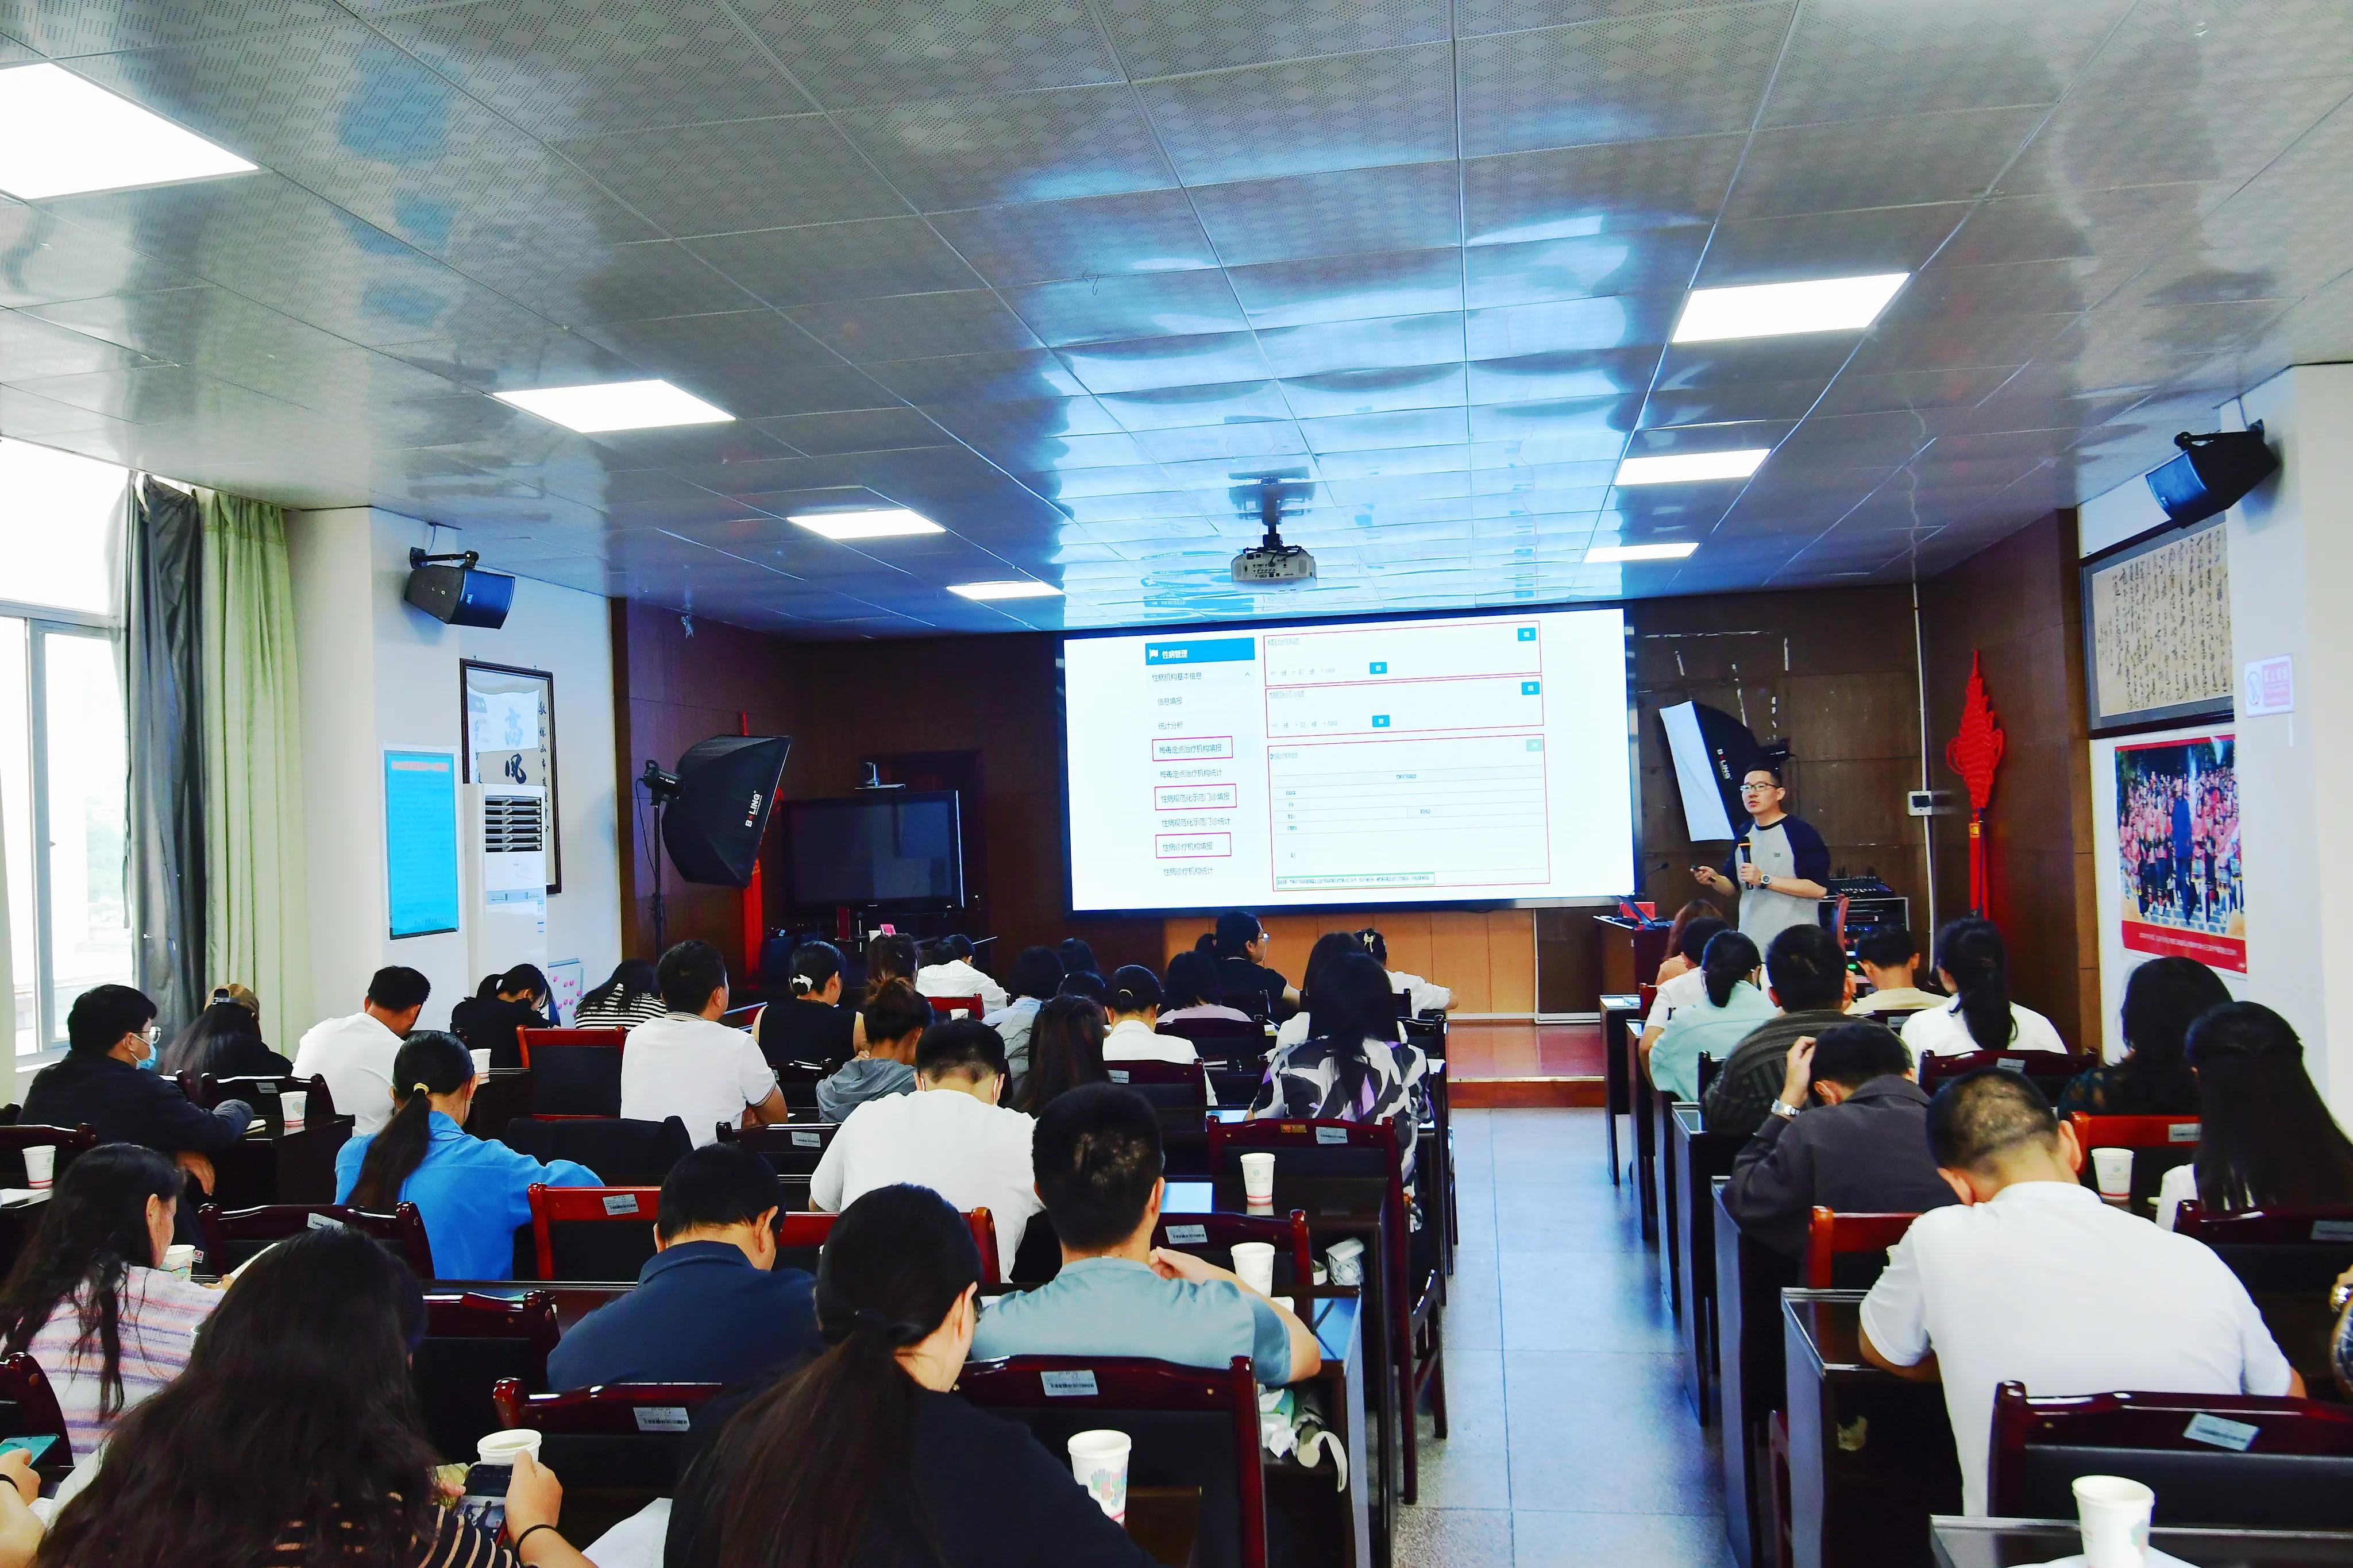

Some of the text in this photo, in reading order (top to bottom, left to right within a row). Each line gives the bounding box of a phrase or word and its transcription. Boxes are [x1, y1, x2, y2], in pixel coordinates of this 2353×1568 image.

[1162, 649, 1188, 659] 性病管理
[1152, 671, 1202, 682] 性病机构基本信息
[1157, 697, 1183, 706] 信息填报
[1158, 721, 1183, 731] 统计分析
[1159, 744, 1222, 754] 梅毒定点治疗机构填报
[1160, 768, 1223, 778] 梅毒定点治疗机构统计
